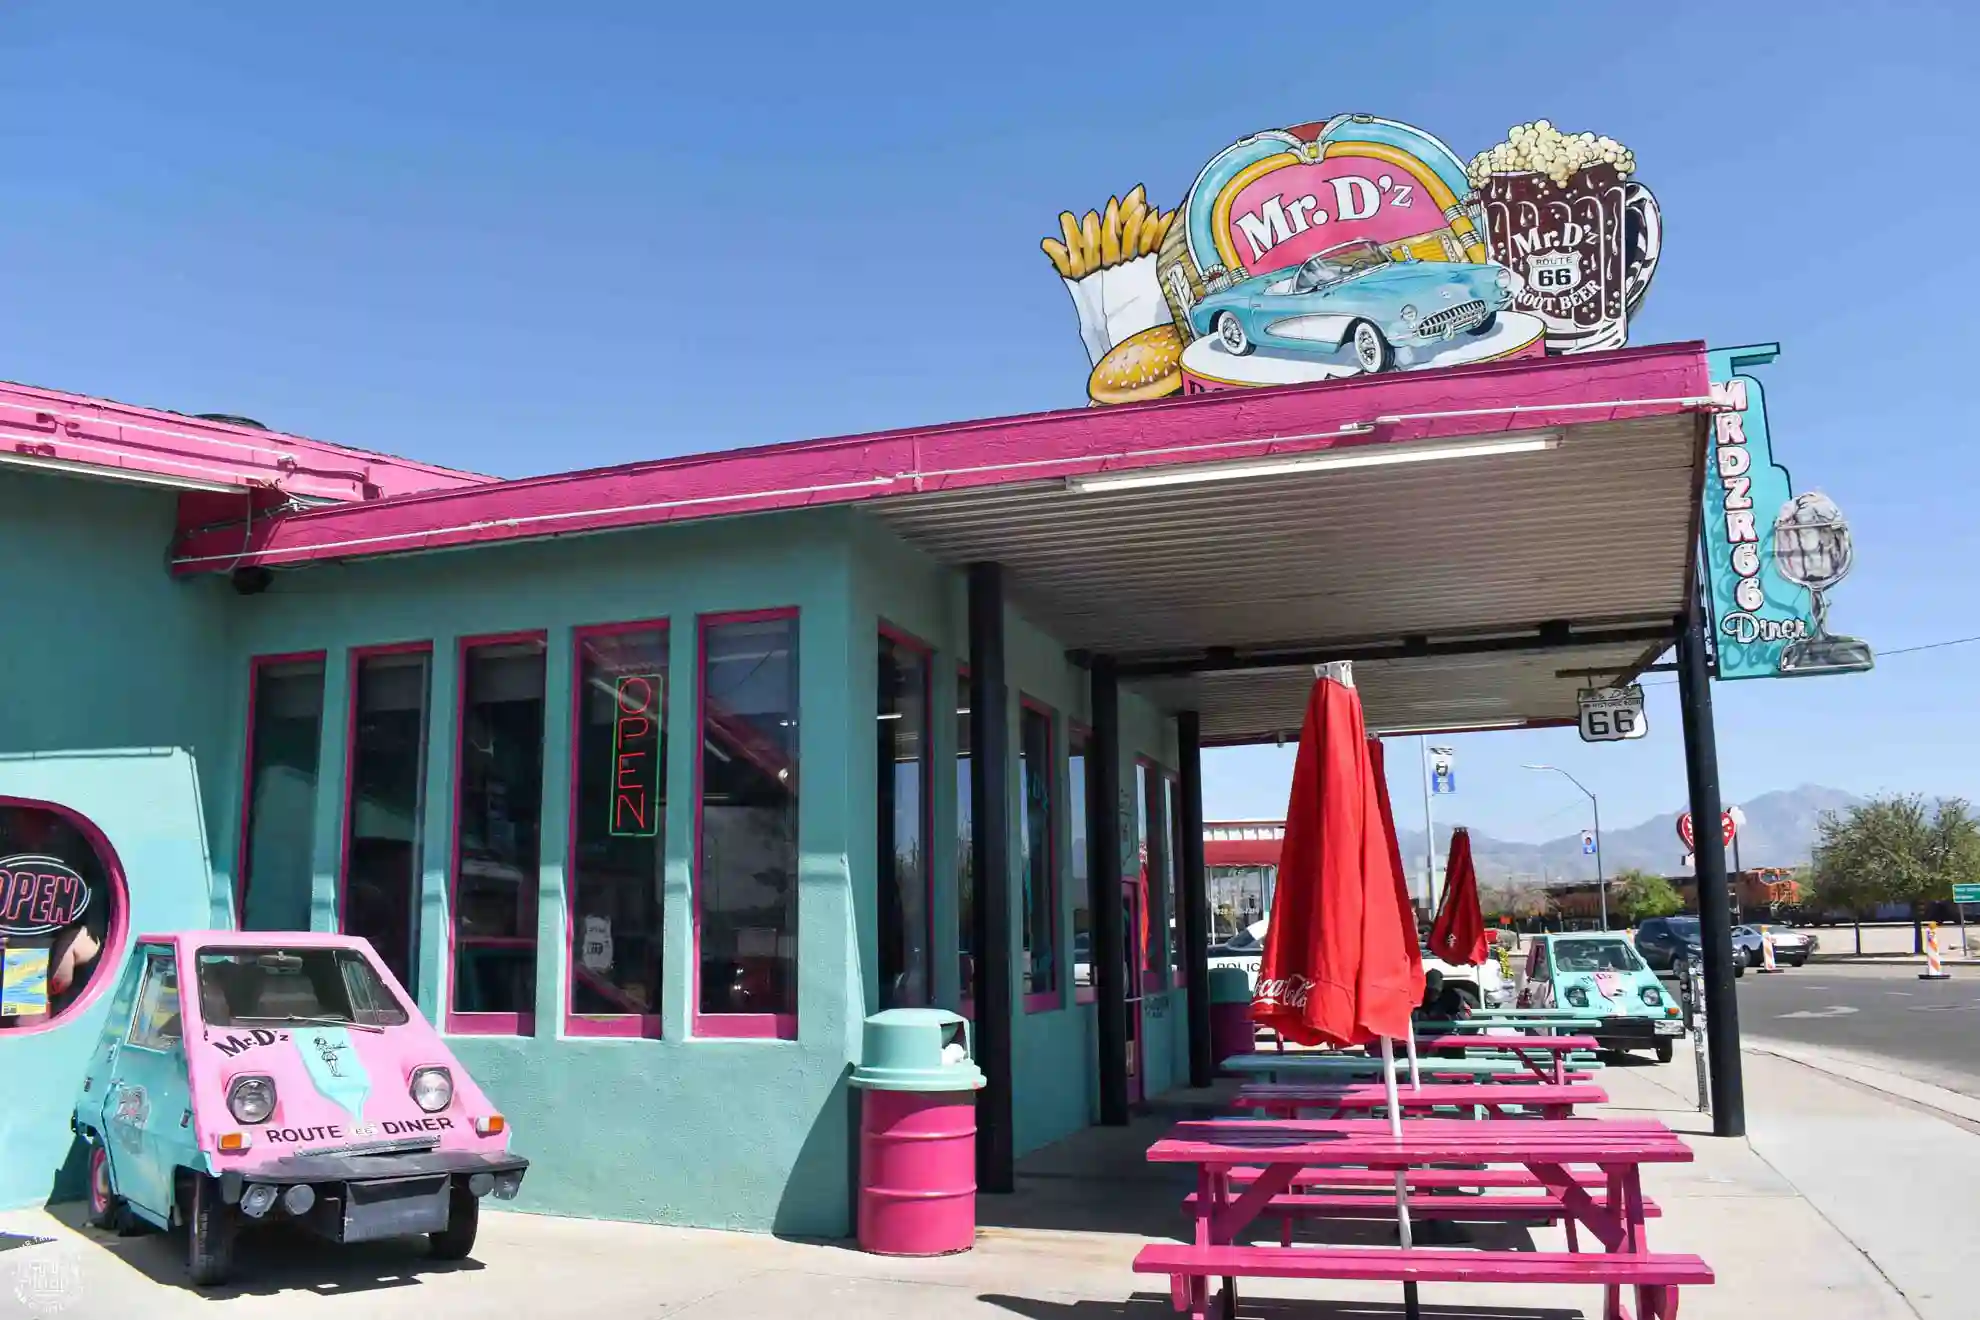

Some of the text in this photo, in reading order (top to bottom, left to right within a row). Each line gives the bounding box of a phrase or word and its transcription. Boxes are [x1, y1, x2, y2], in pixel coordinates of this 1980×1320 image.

[1233, 175, 1414, 264] Mr. D'z
[1536, 257, 1573, 266] ROUTE
[1538, 268, 1571, 287] 66
[1559, 280, 1602, 310] BEER
[1720, 611, 1808, 644] Diner
[1588, 709, 1635, 735] 66
[617, 677, 651, 829] OPEN
[265, 1125, 343, 1144] ROUTE
[382, 1117, 455, 1135] DINER
